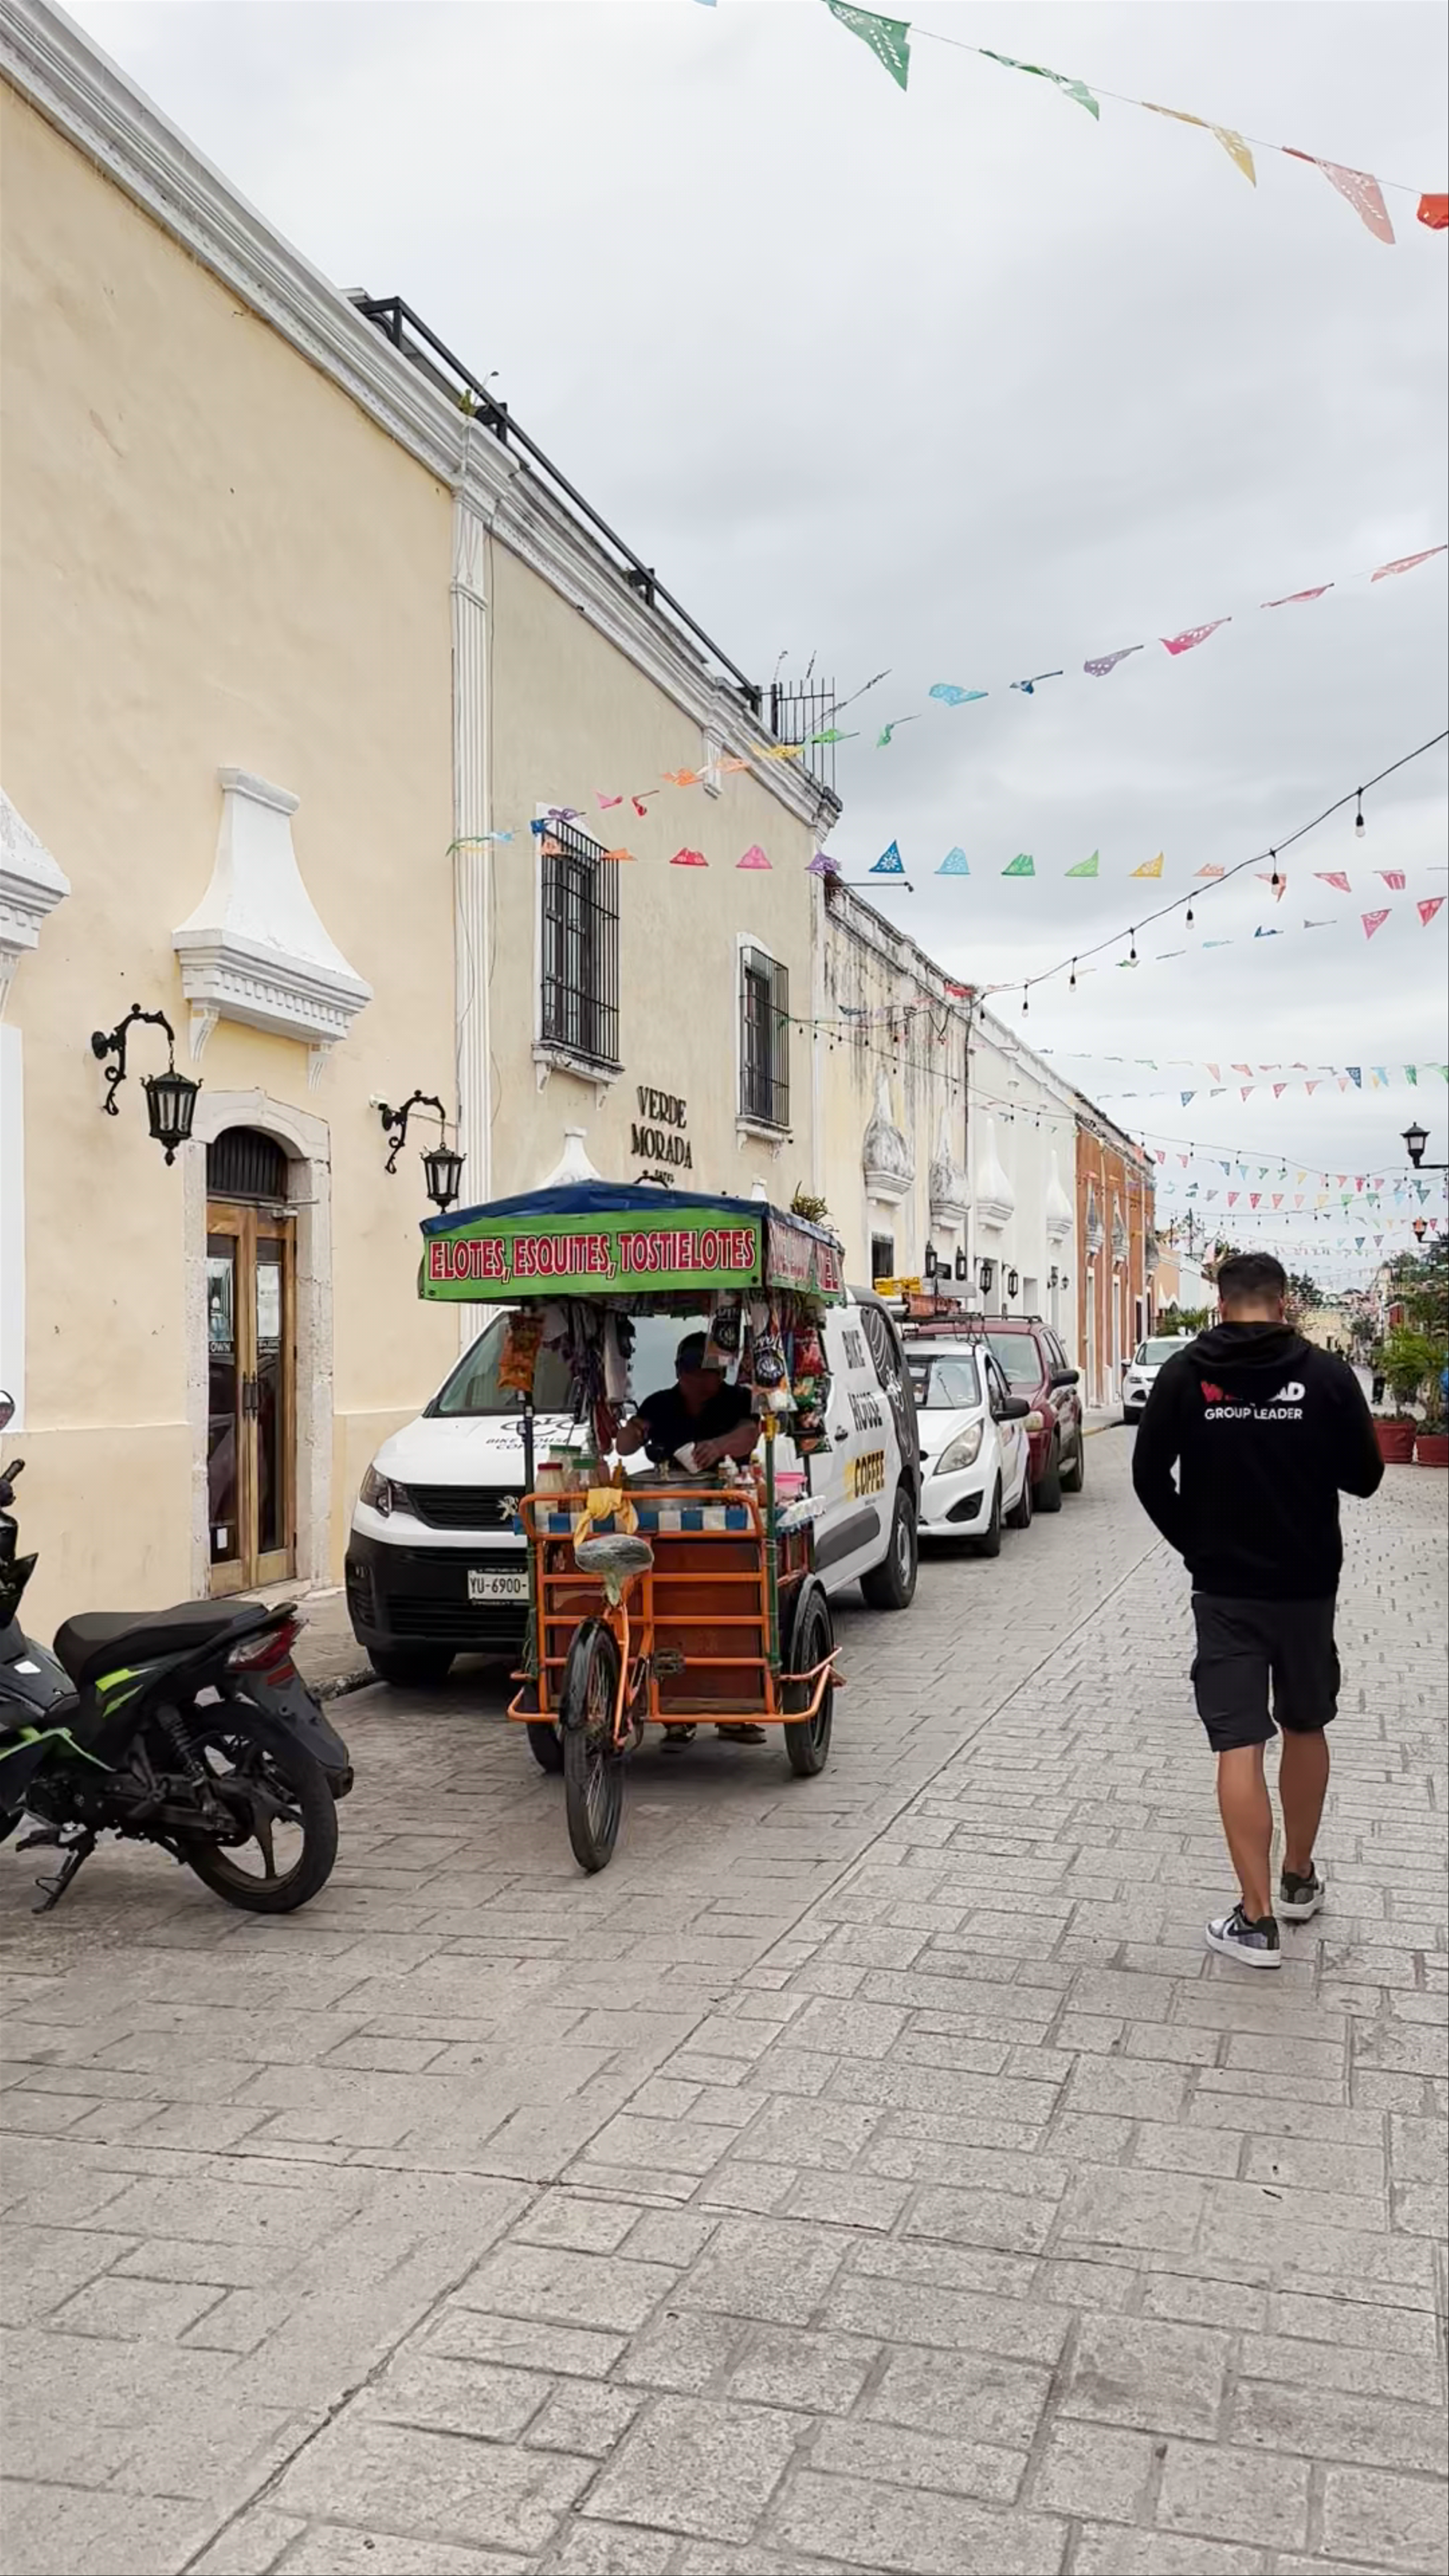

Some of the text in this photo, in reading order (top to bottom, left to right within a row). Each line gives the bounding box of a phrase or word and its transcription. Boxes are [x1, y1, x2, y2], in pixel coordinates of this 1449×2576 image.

[636, 1086, 687, 1129] VERDE
[631, 1123, 692, 1169] MORADA
[429, 1239, 510, 1284] ELOTES,
[513, 1233, 617, 1279] ESQUITES,
[617, 1228, 756, 1272] TOSTIELOTES
[842, 1330, 865, 1369] BIKE
[1204, 1407, 1303, 1419] GROUP LEADER
[855, 1450, 884, 1498] COFFEE
[470, 1577, 528, 1593] YU-6900-
